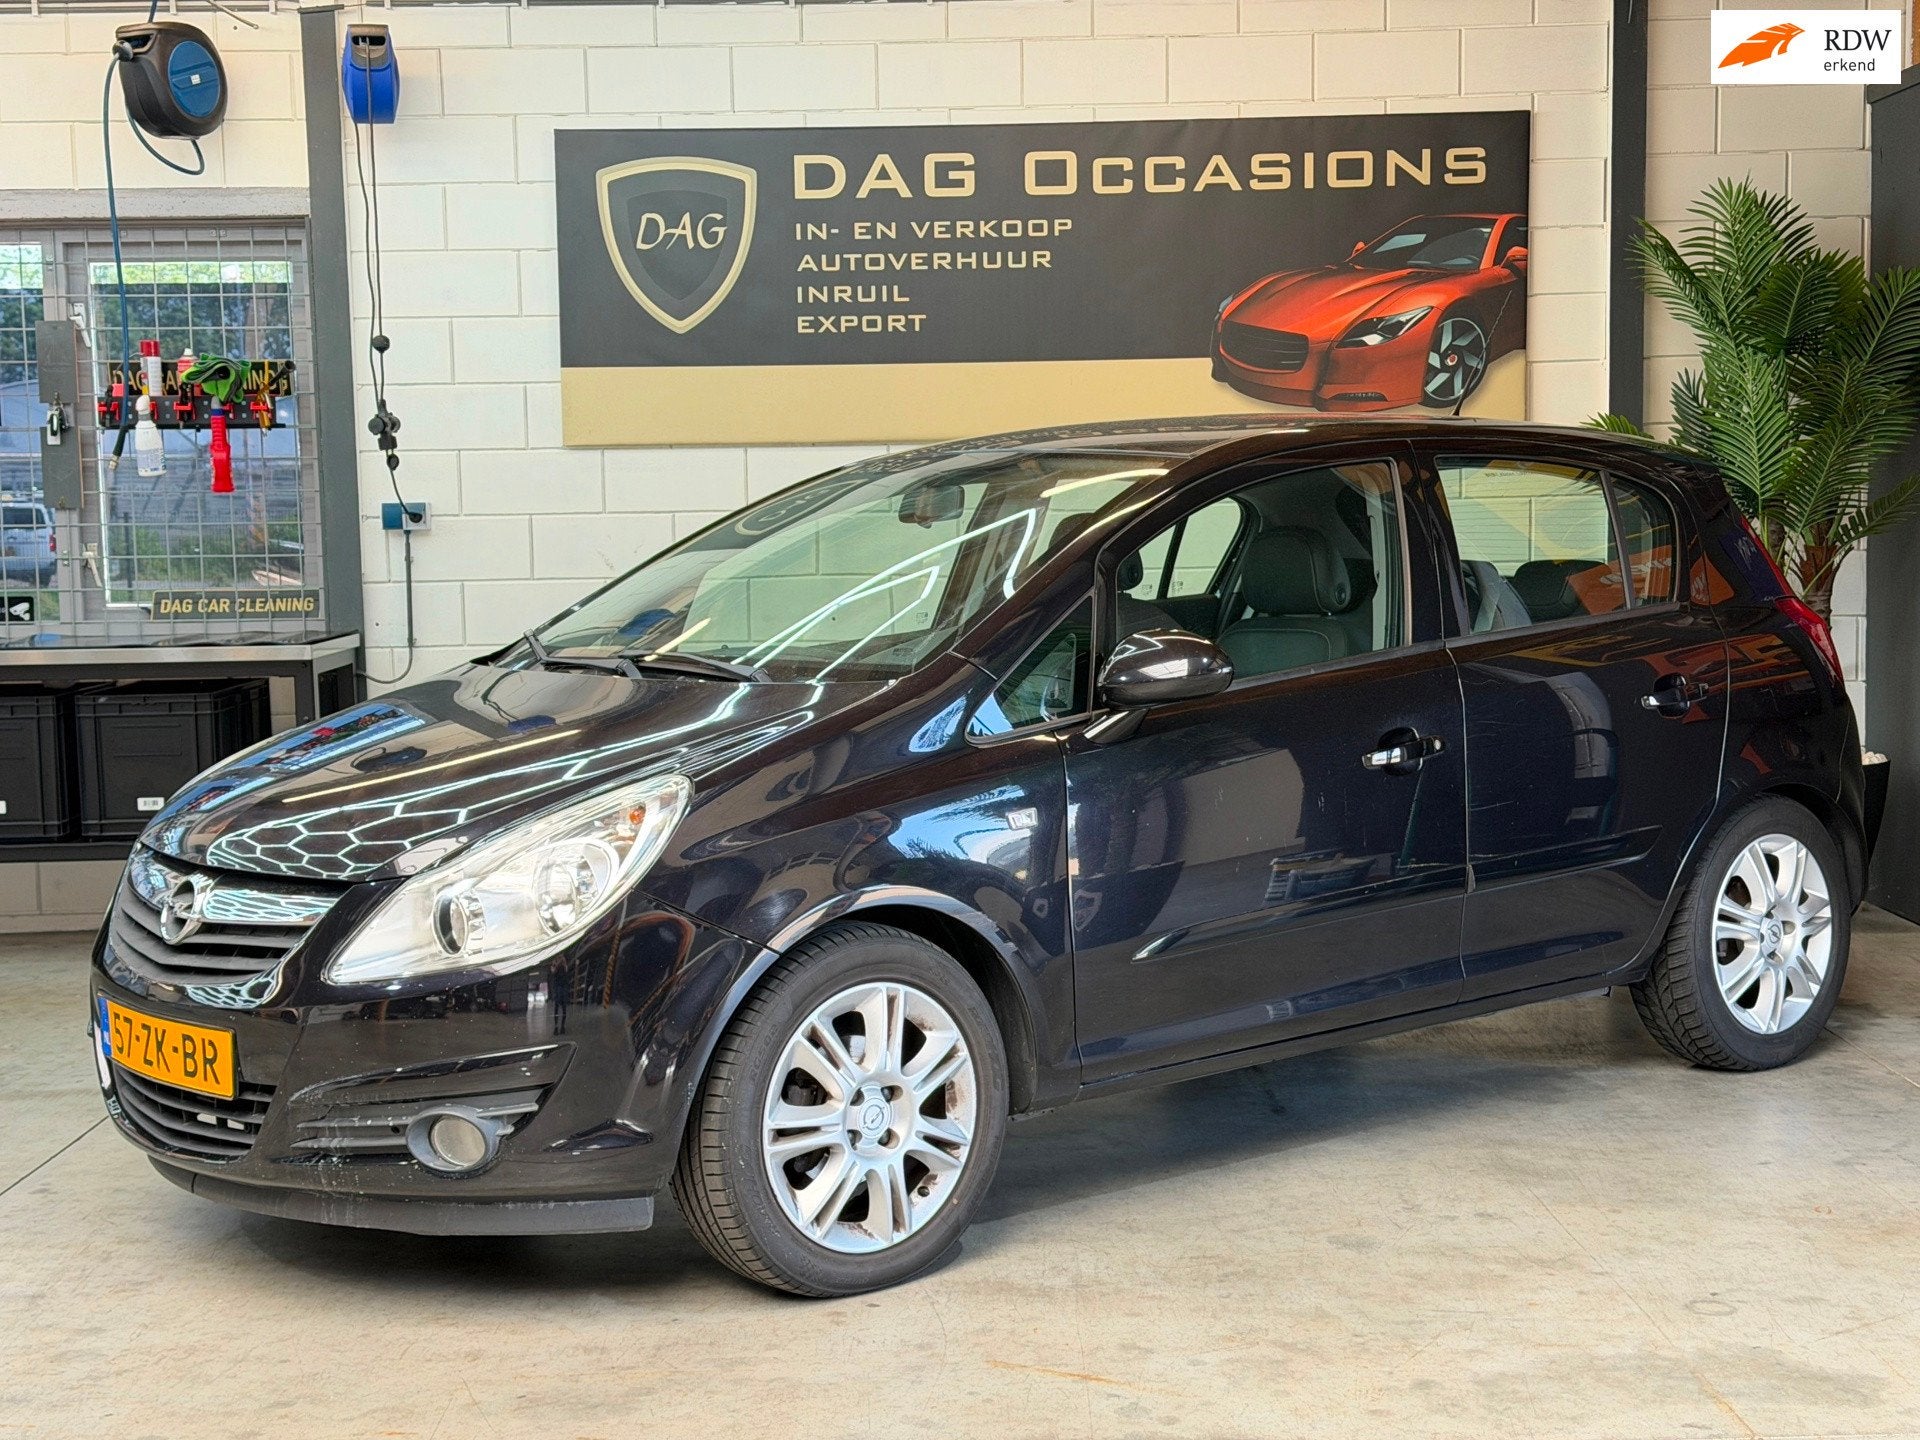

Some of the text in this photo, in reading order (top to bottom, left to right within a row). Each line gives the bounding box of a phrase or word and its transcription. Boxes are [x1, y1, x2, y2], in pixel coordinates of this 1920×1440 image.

[793, 147, 1487, 199] DAG OCCASIONS
[635, 211, 728, 251] DAG
[795, 219, 1074, 241] IN- EN VERKOOP
[796, 249, 1052, 272] AUTOVERHUUR
[796, 285, 910, 304] INRUIL
[796, 314, 927, 334] EXPORT
[160, 597, 314, 613] DAG CAR CLEANING
[113, 1011, 221, 1085] 57-ZK-BR
